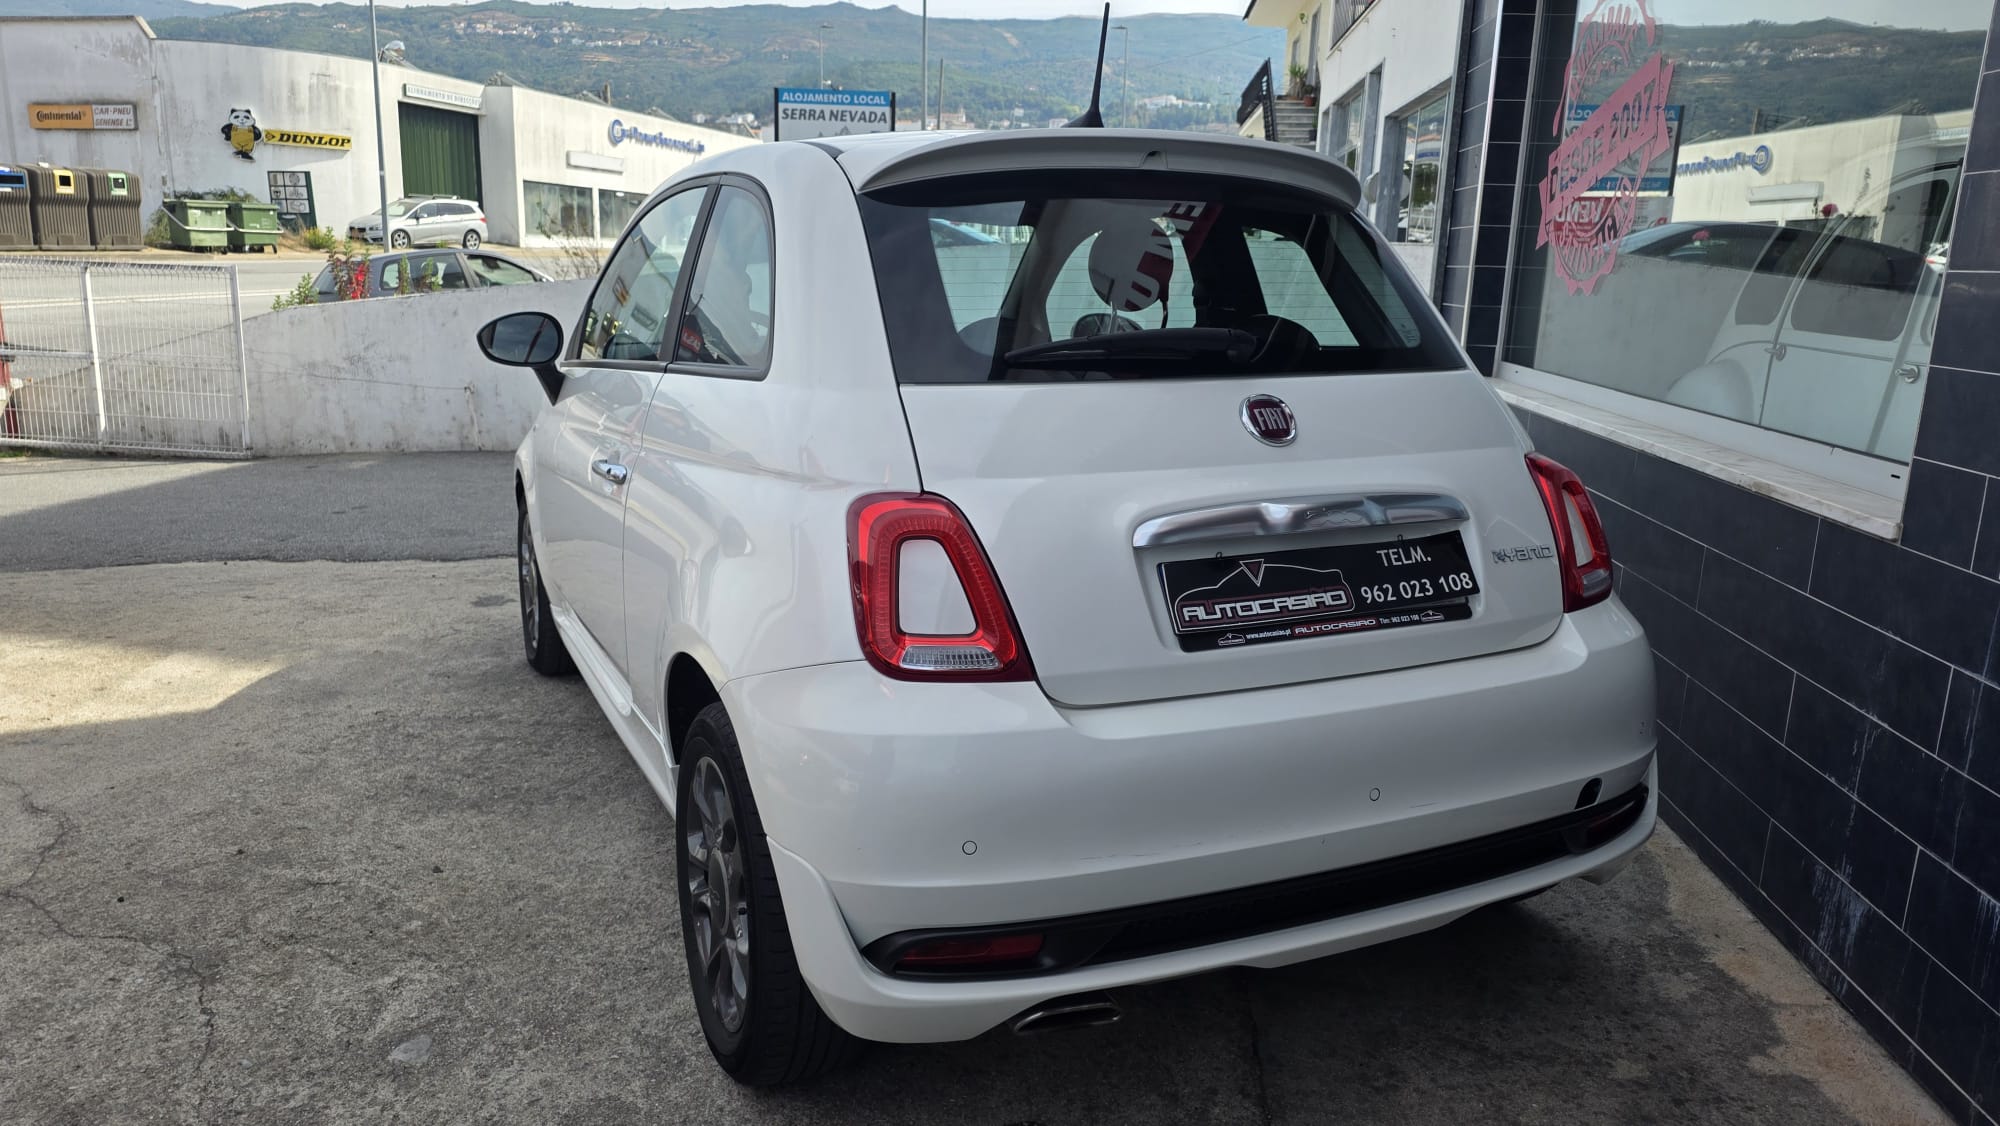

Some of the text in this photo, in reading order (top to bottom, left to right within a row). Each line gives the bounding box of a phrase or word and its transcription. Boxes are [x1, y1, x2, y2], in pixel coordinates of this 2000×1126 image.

[782, 92, 886, 104] ALOJAMENTO LOCAL
[36, 110, 82, 122] Continental
[781, 108, 888, 124] SERRA NEVADA
[278, 133, 351, 147] DUNLOP
[1549, 78, 1656, 205] DESDE 2007
[1253, 407, 1288, 431] FIAT
[1376, 546, 1431, 567] TELM.
[1490, 545, 1554, 564] HYBRID
[1361, 572, 1473, 604] 962 023 108
